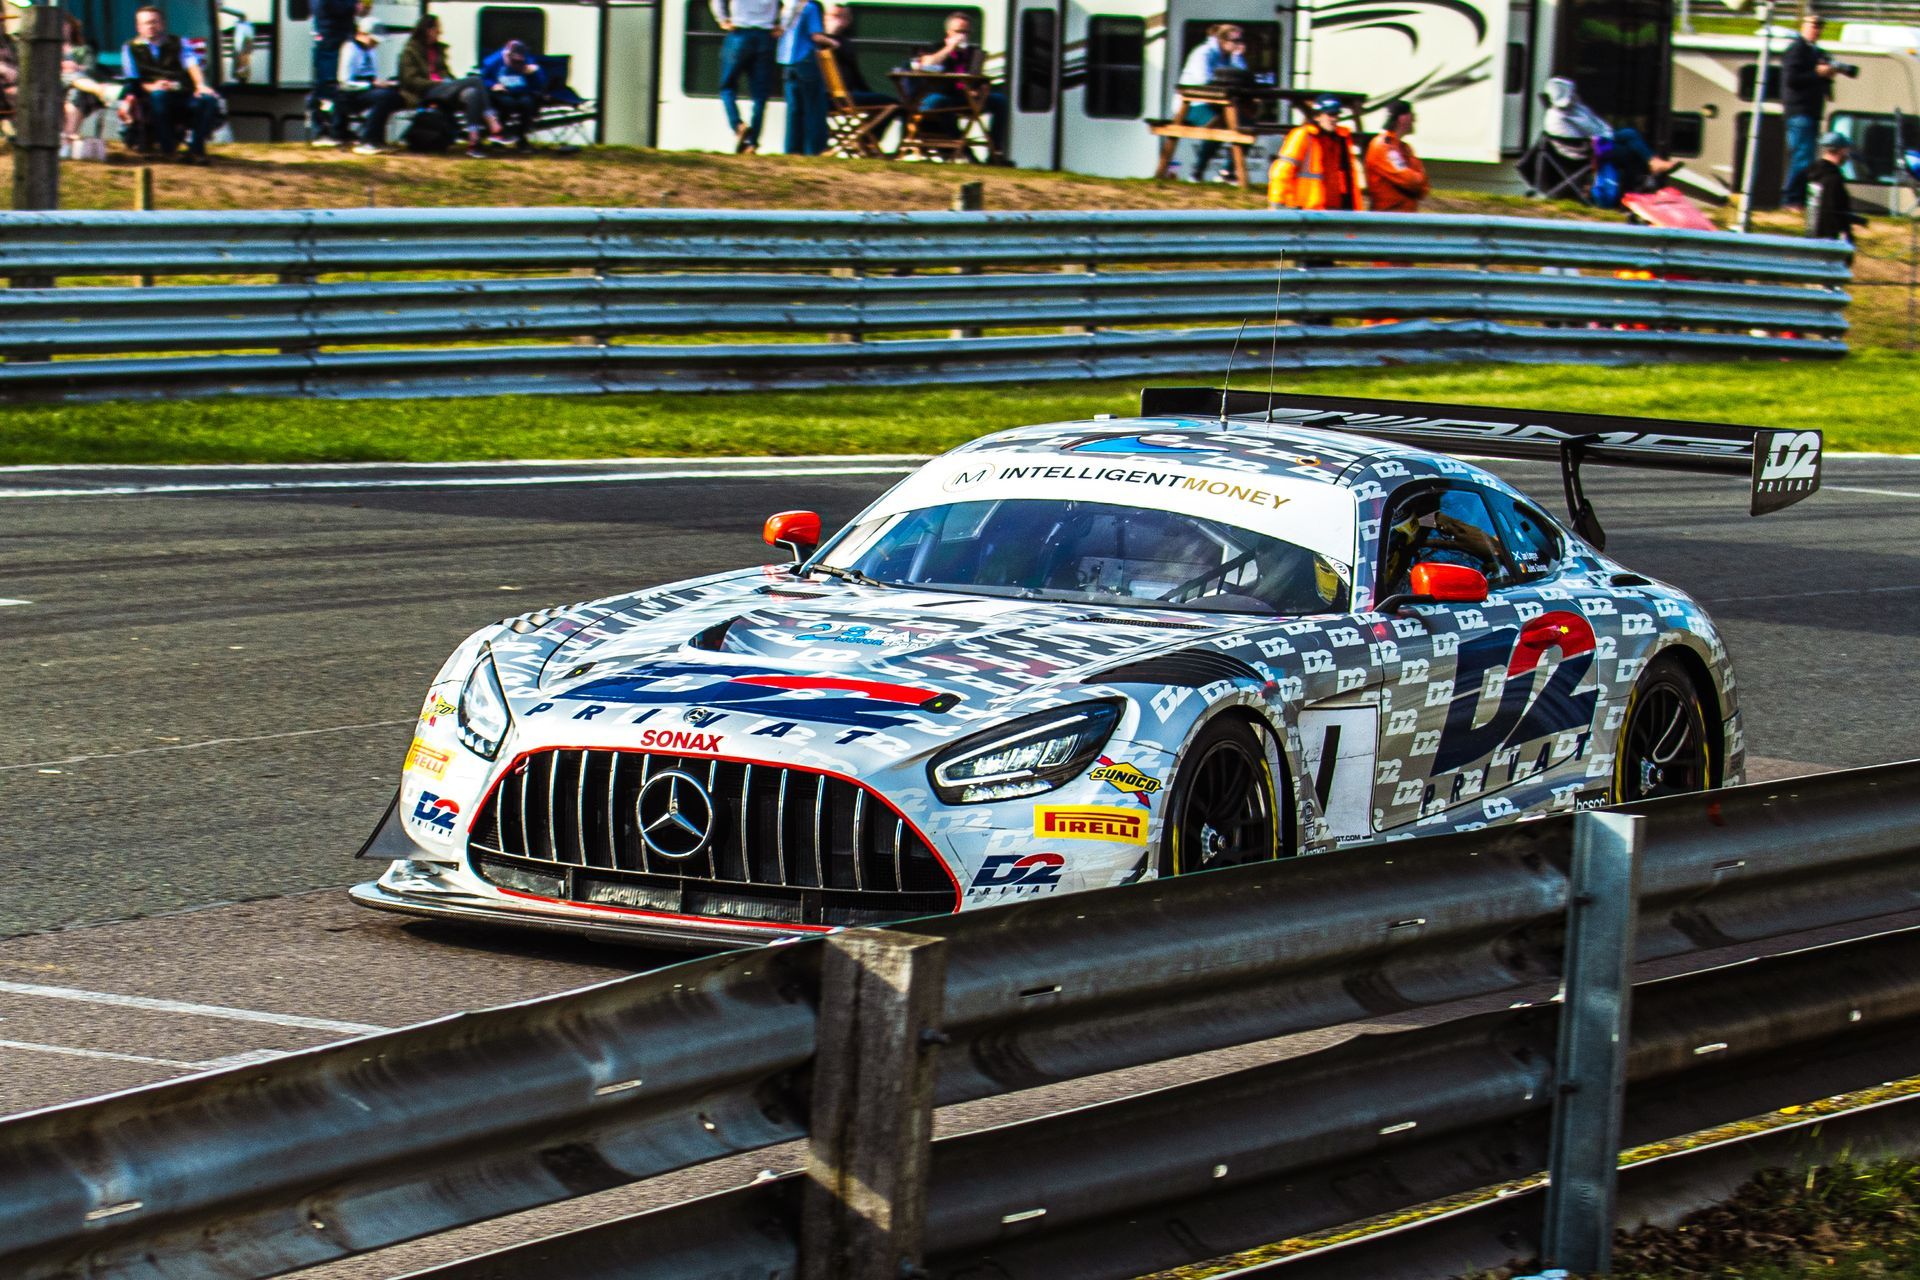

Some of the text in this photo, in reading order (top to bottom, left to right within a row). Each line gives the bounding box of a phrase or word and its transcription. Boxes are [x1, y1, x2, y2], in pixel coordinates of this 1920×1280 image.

[1761, 431, 1820, 480] D2
[1371, 460, 1411, 478] D2
[1349, 480, 1388, 502] D2
[1757, 479, 1813, 493] PRIVAT
[1453, 609, 1488, 630] D2
[1513, 602, 1544, 622] D2
[1579, 598, 1617, 616] D2
[1390, 618, 1428, 638] D2
[1622, 613, 1656, 635] D2
[1256, 637, 1296, 658] D2
[1325, 627, 1365, 648] D2
[1432, 632, 1460, 657] D2
[1301, 650, 1336, 674] D2
[1369, 640, 1401, 666] D2
[1336, 667, 1367, 694] D2
[1398, 658, 1430, 685] D2
[1277, 676, 1304, 702] D2
[1424, 680, 1455, 707] D2
[1430, 610, 1600, 777] D2
[524, 702, 877, 745] PRIVAT
[1385, 709, 1418, 736] D2
[640, 729, 724, 752] SONAX
[1409, 729, 1441, 757] D2
[1093, 769, 1159, 791] SUNOCO
[1420, 732, 1592, 815] PRIVAT
[1391, 779, 1424, 806] D2
[413, 791, 460, 830] D2
[1483, 797, 1520, 819] D2
[1044, 811, 1140, 839] PIRELLI
[971, 853, 1065, 887] D2
[966, 884, 1059, 897] PRIVAT
